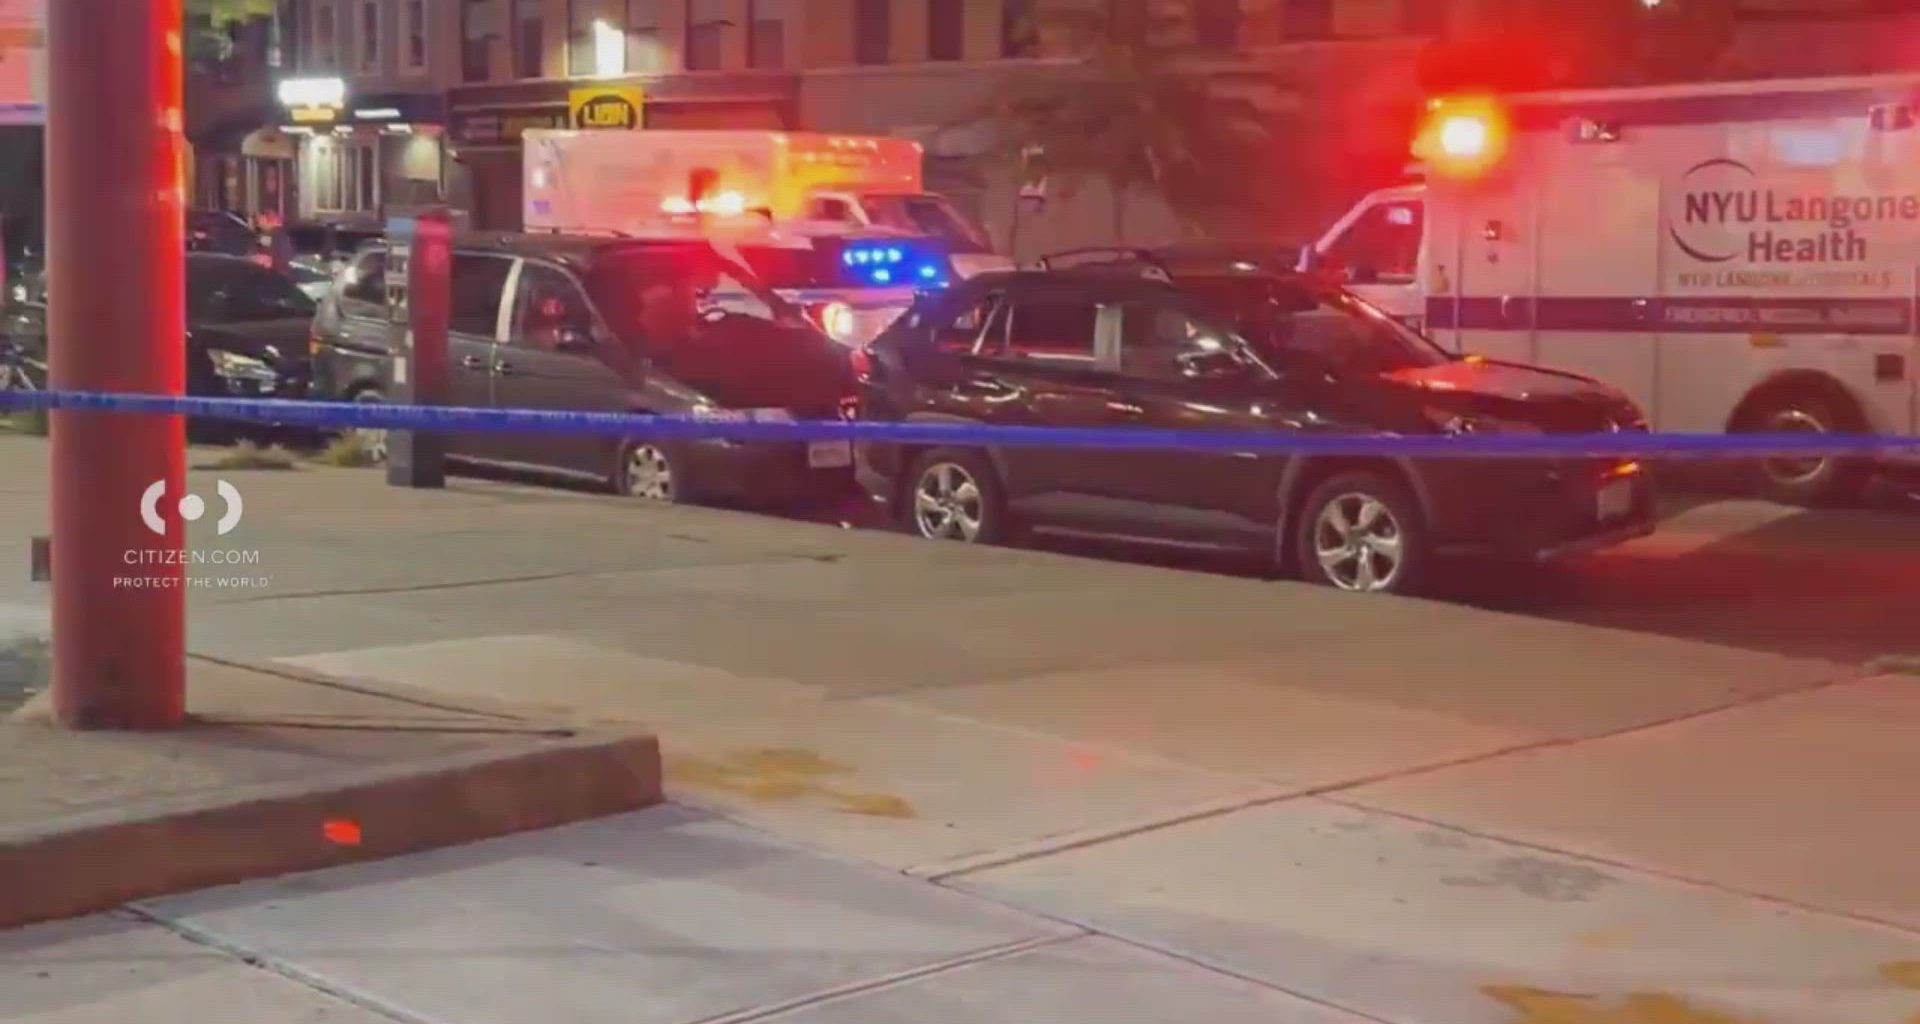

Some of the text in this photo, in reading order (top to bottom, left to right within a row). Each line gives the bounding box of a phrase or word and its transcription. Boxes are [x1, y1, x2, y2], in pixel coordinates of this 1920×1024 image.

[1686, 190, 1920, 228] NYU Langone
[1747, 231, 1867, 263] Health
